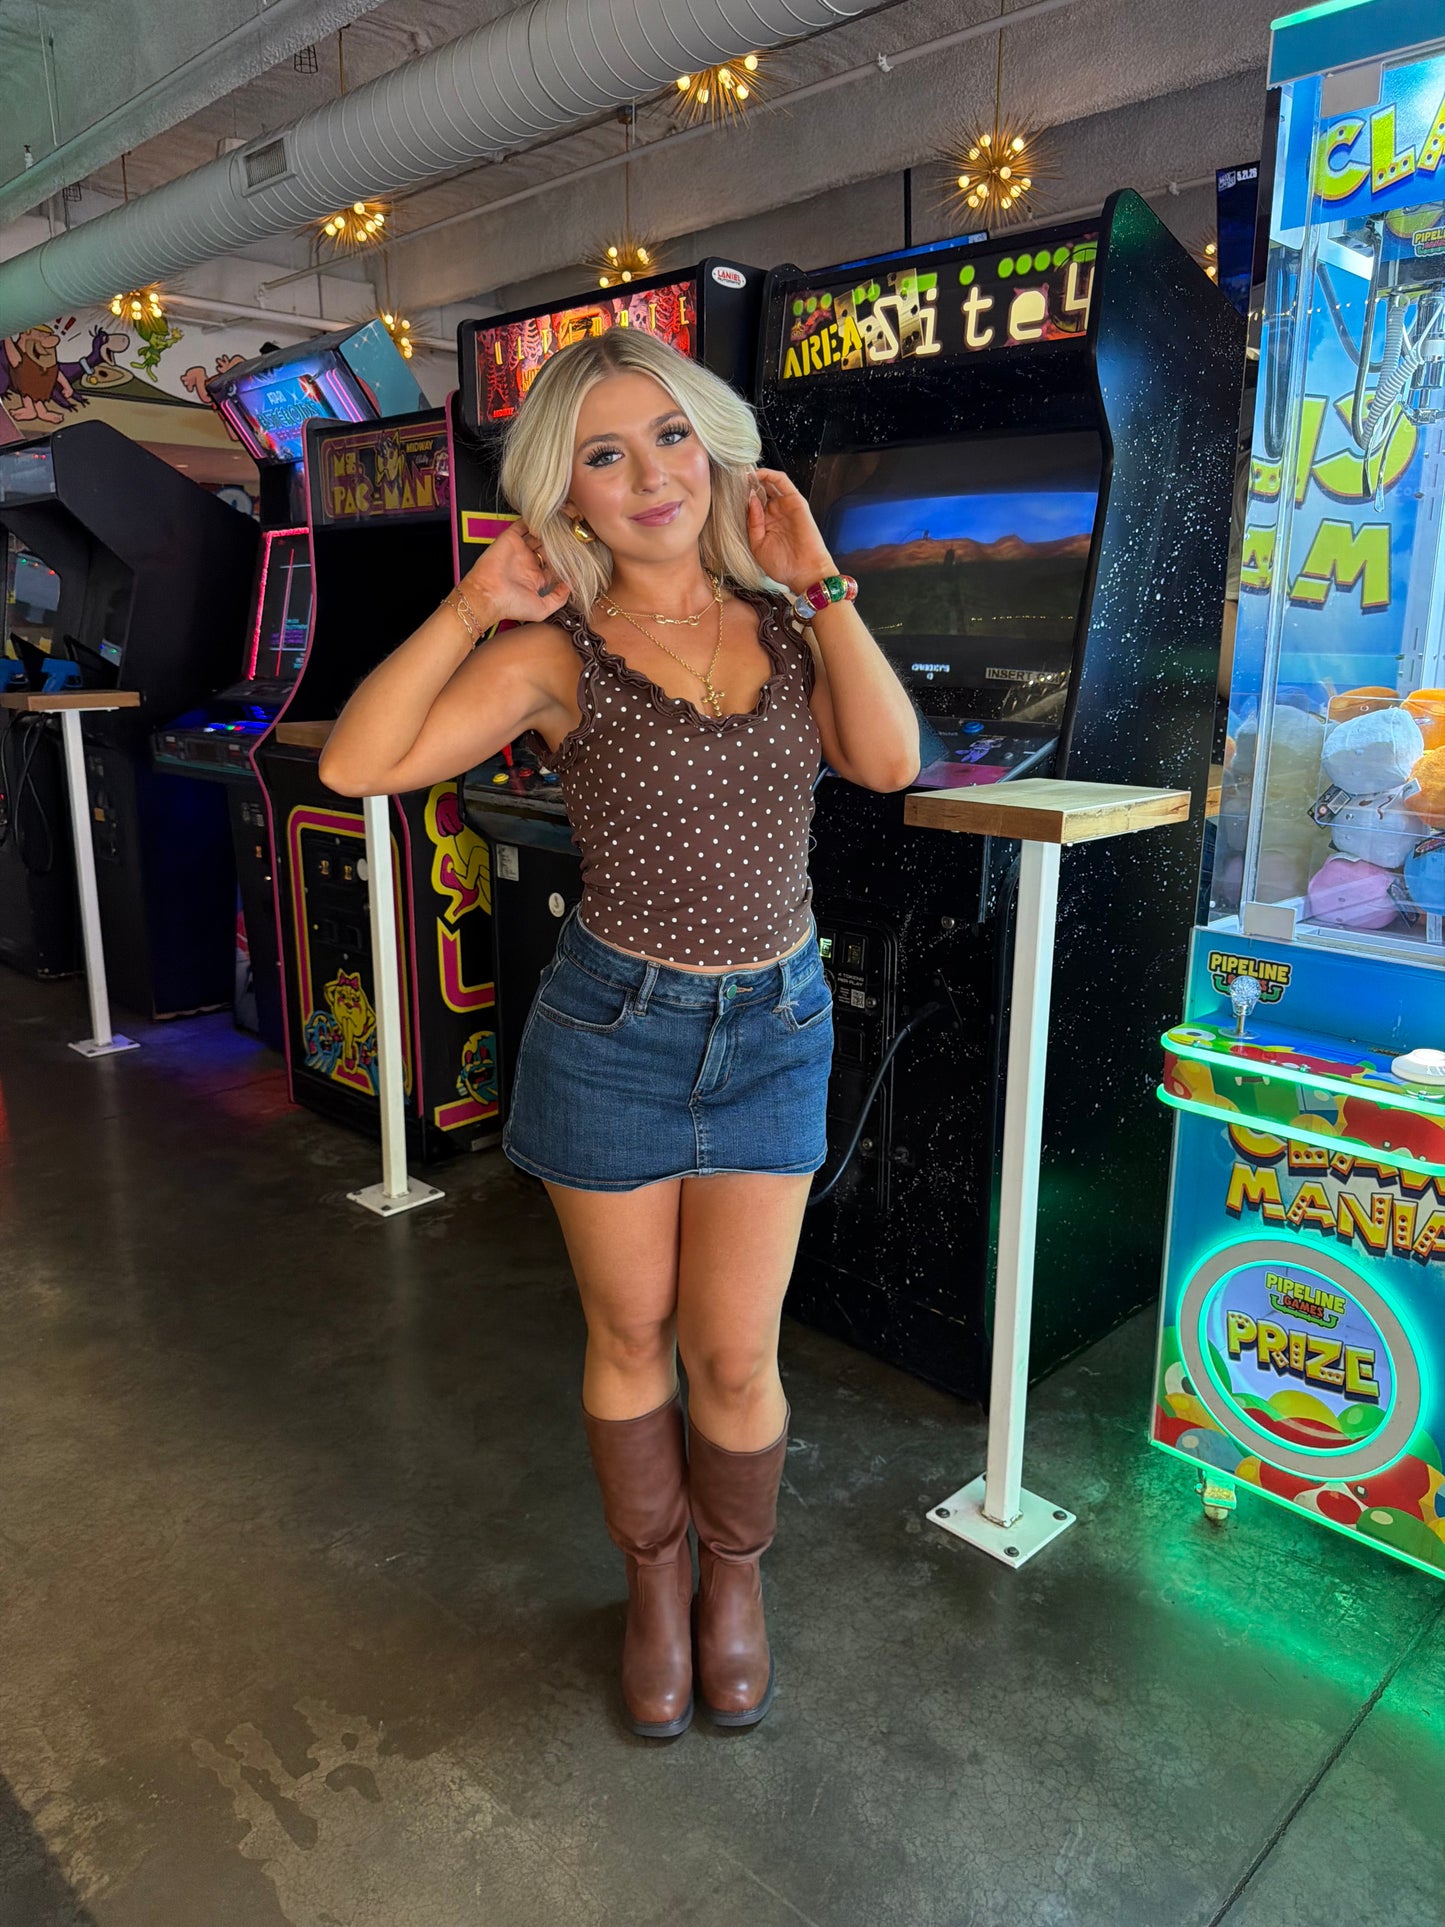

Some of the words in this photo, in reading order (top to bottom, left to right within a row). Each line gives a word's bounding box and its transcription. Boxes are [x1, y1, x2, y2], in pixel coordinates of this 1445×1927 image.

[1415, 228, 1445, 244] PIPEL
[717, 269, 741, 282] LANIEL
[783, 316, 863, 379] AREA
[406, 440, 433, 453] MIDWAY
[333, 474, 434, 515] PAC-MAN
[987, 668, 1032, 681] INSERT
[1210, 953, 1289, 983] PIPELINE
[1226, 1162, 1445, 1258] MANIA
[1266, 1272, 1346, 1315] PIPELINE
[1284, 1295, 1325, 1319] GAMES
[1227, 1310, 1380, 1400] PRIZE
